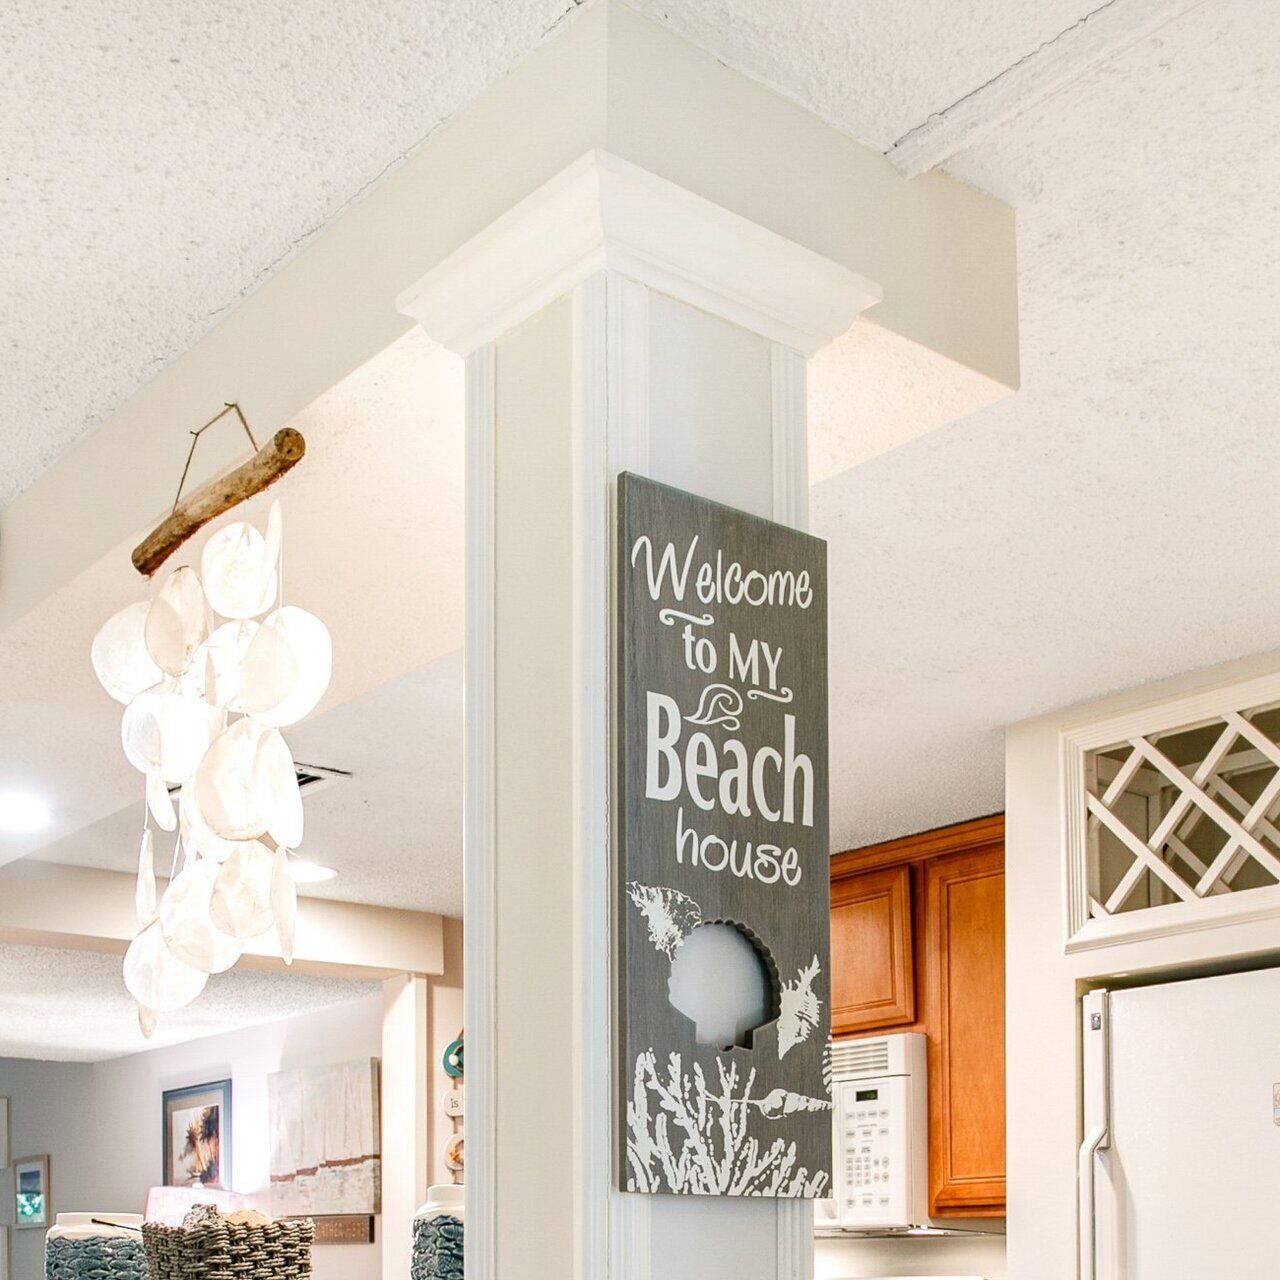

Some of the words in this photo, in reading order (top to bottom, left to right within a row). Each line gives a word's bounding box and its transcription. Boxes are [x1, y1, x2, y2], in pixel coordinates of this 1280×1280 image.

[630, 534, 814, 609] Welcome
[681, 623, 718, 674] to
[728, 632, 783, 690] MY
[645, 690, 815, 828] Beach
[675, 806, 803, 887] house
